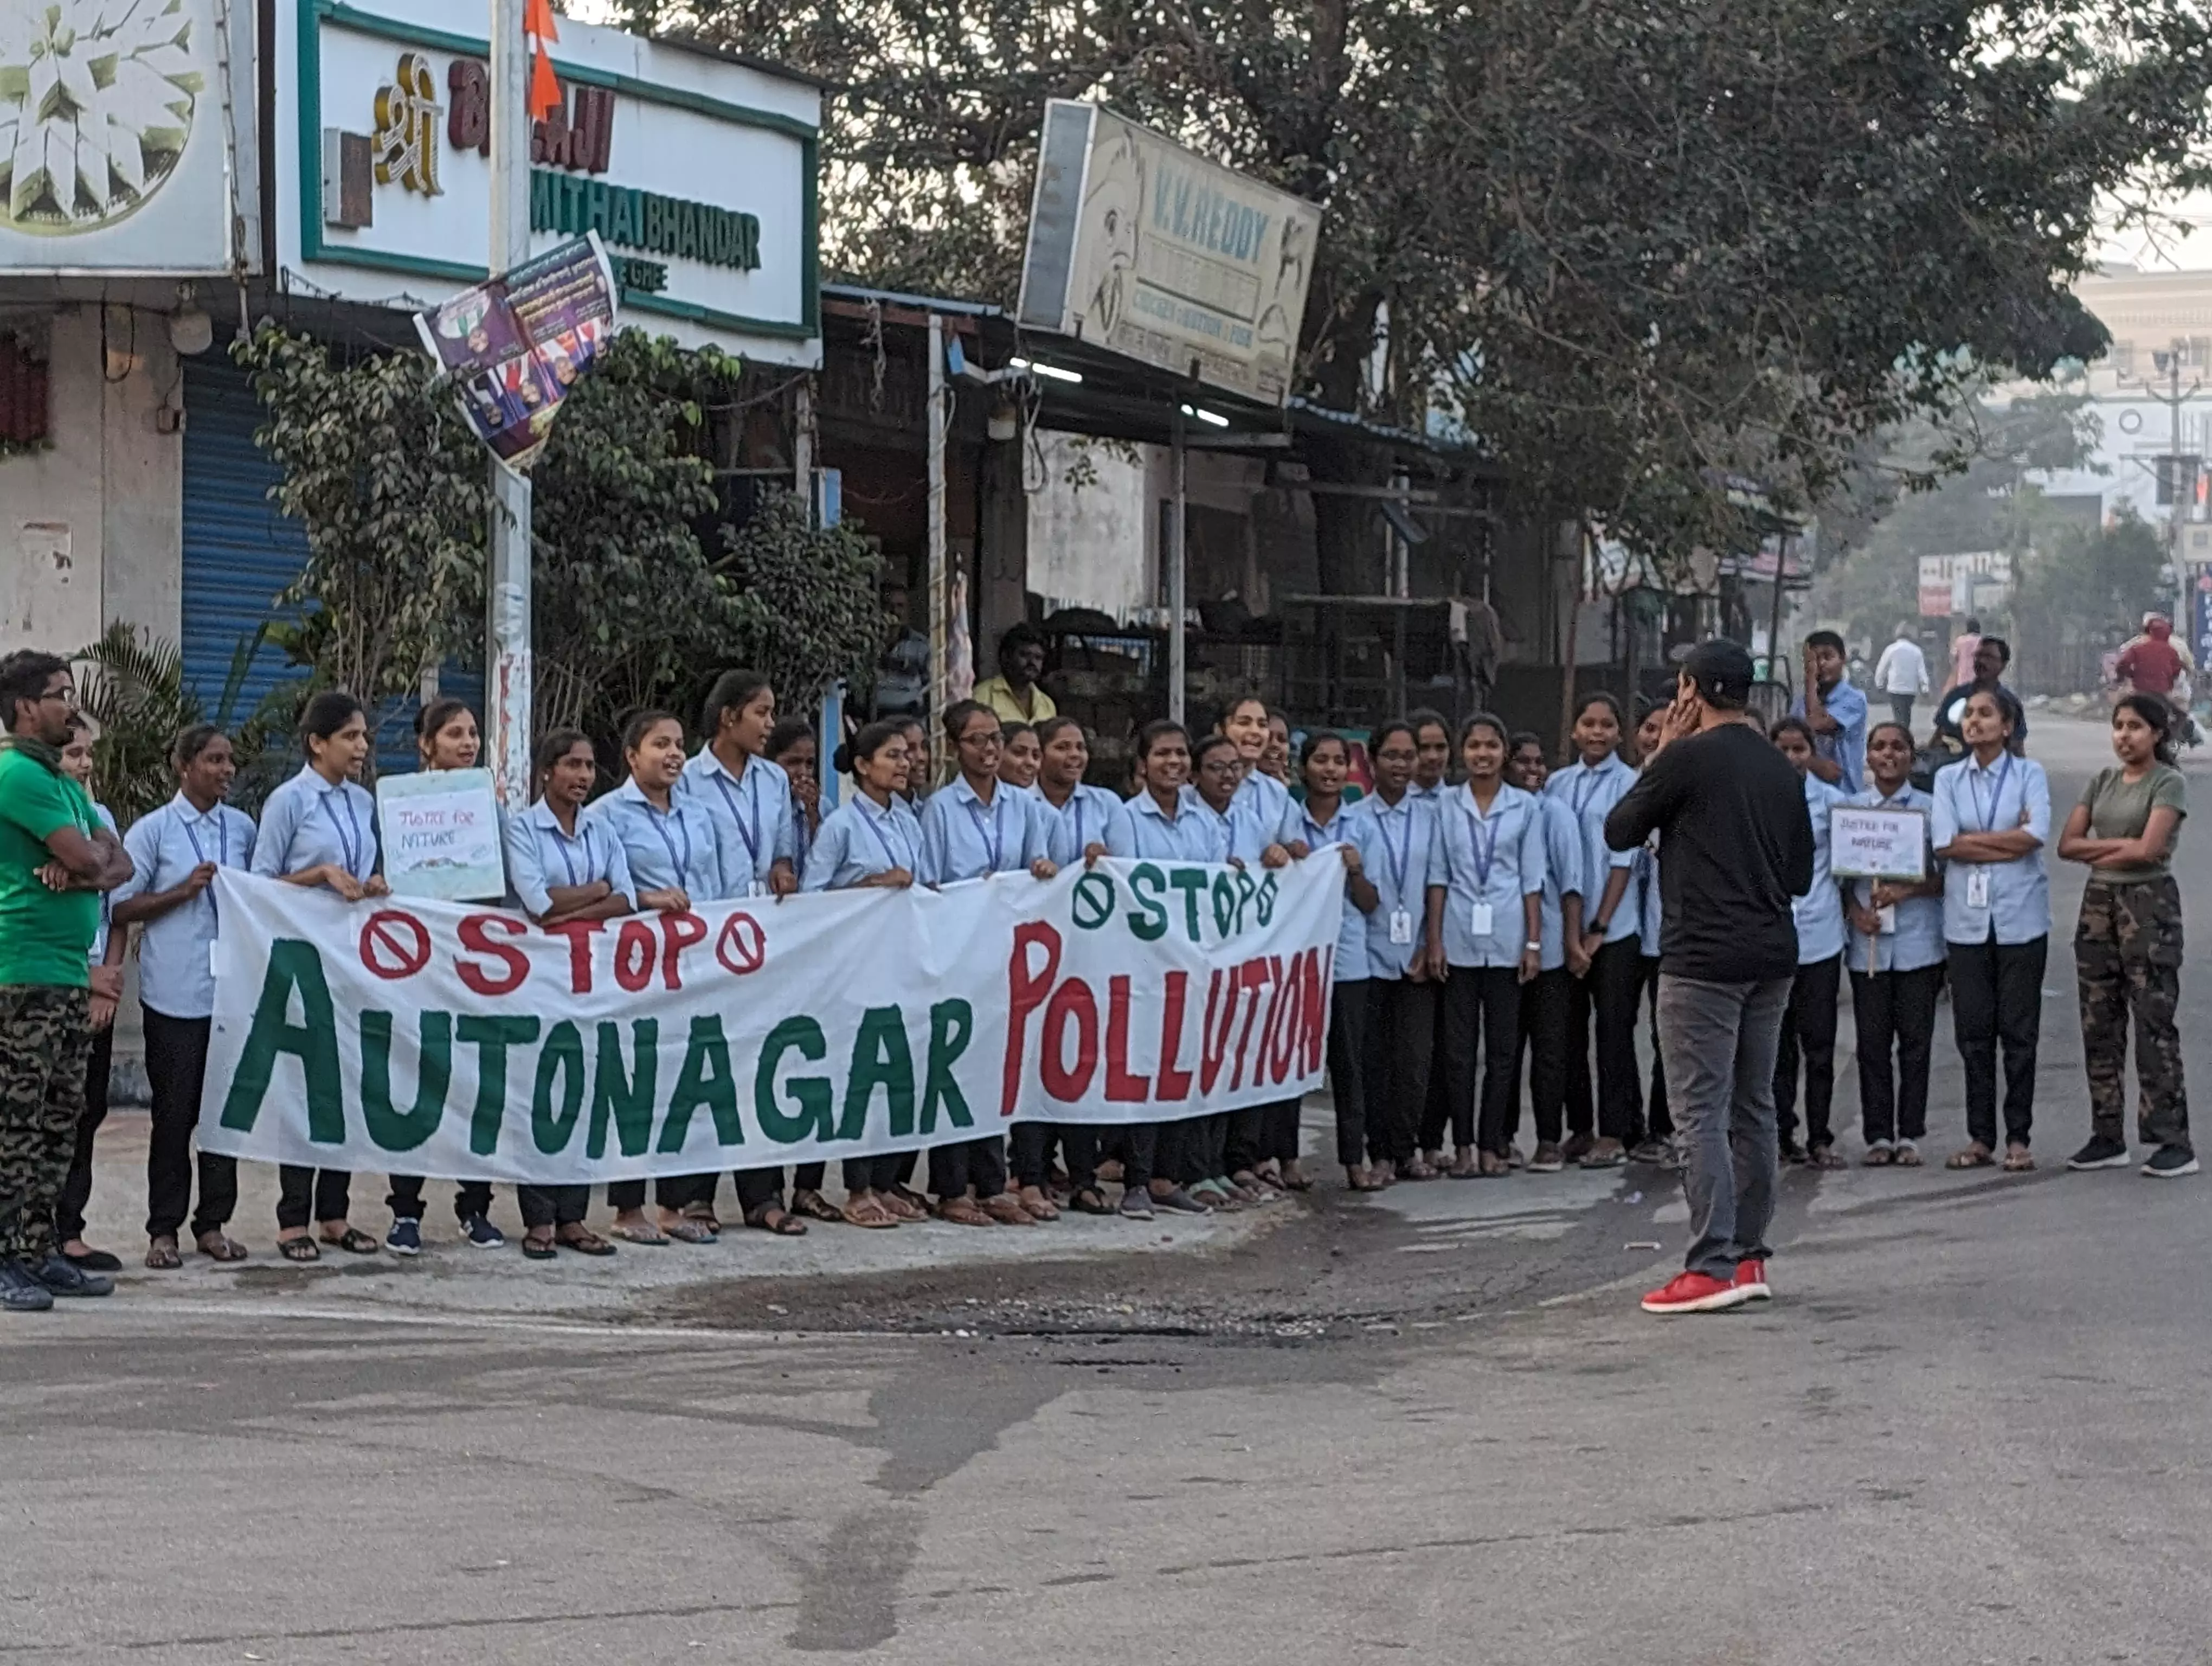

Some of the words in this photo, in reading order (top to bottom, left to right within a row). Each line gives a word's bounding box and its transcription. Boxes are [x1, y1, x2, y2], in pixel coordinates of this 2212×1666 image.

[372, 53, 444, 196] श्री
[645, 191, 761, 272] BHANDAR
[627, 259, 668, 292] GHEE
[402, 830, 454, 849] NATURE
[1128, 862, 1256, 942] STOP
[453, 910, 708, 995] STOP
[220, 938, 974, 1159] AUTONAGAR
[1001, 920, 1333, 1116] POLLUTION
